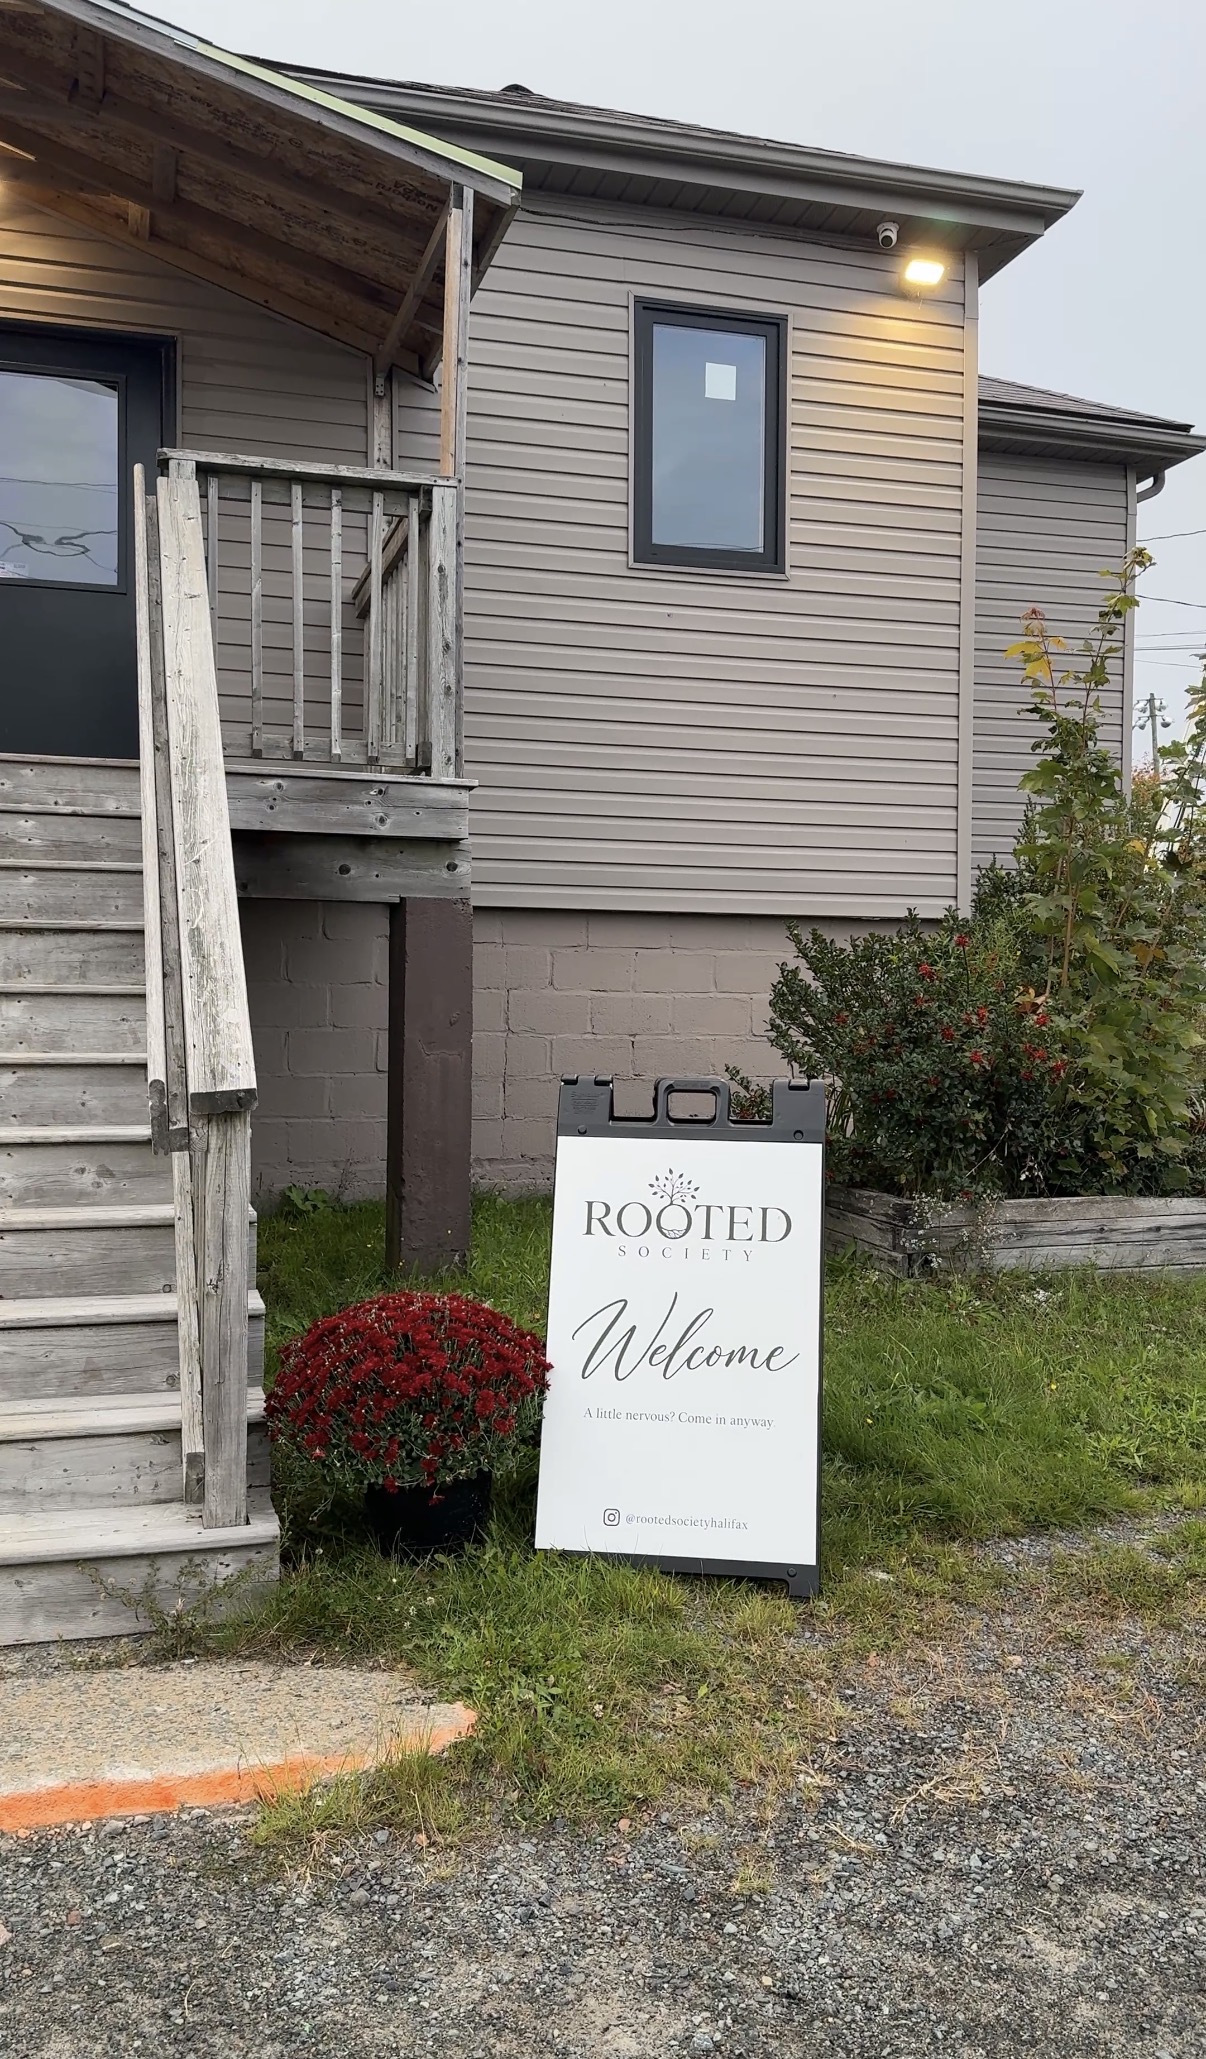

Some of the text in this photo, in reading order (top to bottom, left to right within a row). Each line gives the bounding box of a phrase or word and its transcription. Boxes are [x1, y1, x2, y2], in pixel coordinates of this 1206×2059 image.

[582, 1200, 793, 1243] ROOTED
[617, 1244, 753, 1262] SOCIETY
[571, 1291, 801, 1382] Welcome
[583, 1407, 594, 1419] A
[596, 1407, 622, 1420] little
[625, 1410, 676, 1423] nervous?
[678, 1411, 712, 1425] Come
[715, 1413, 726, 1426] in
[625, 1513, 749, 1531] @rootedsocietyhalifax
